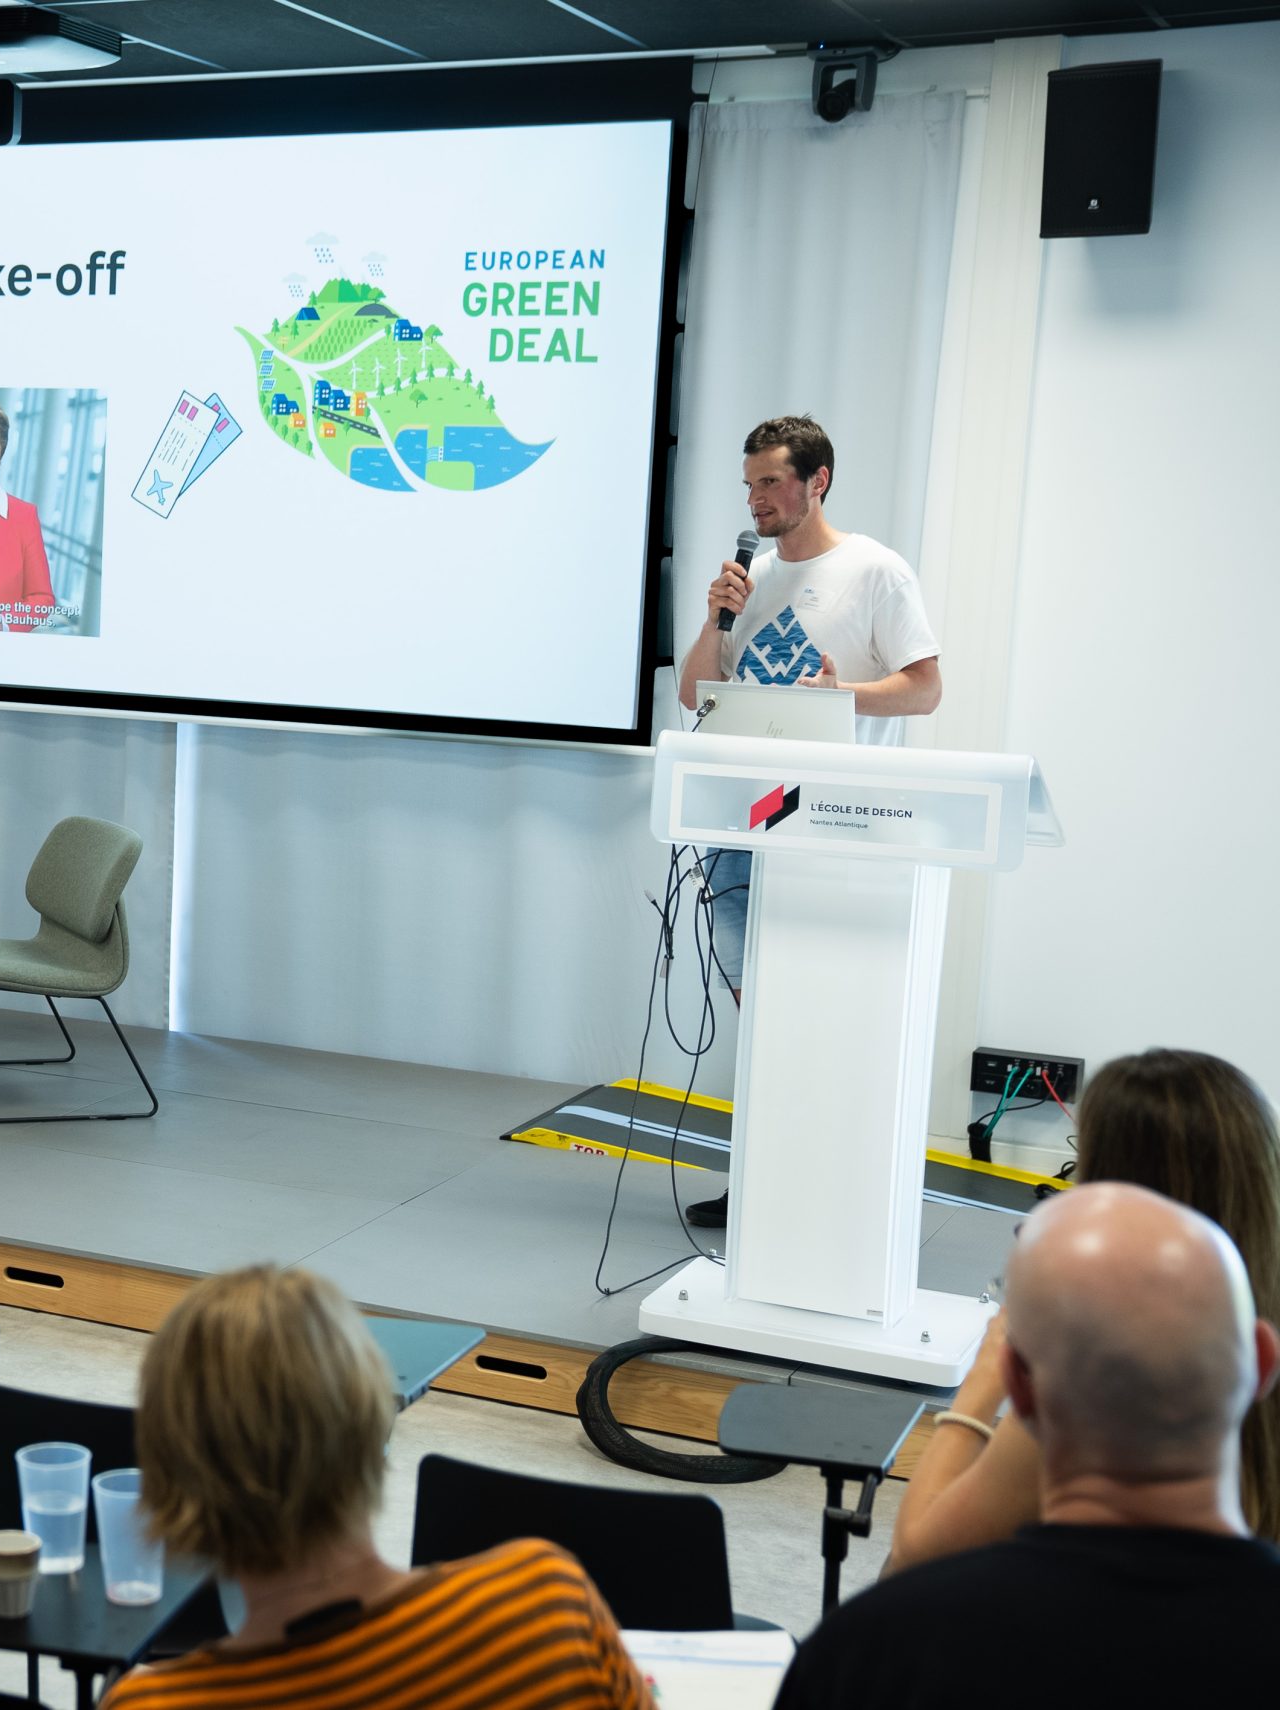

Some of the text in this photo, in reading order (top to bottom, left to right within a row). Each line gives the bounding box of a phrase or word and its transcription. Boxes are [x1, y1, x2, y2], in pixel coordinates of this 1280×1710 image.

[464, 248, 606, 271] EUROPEAN
[462, 280, 601, 318] GREEN
[488, 327, 599, 363] DEAL
[14, 602, 32, 613] the
[34, 604, 81, 617] concept
[5, 613, 56, 627] Bauhaus.
[810, 800, 913, 818] L'ÉCOLE DE DESIGN
[834, 820, 869, 829] Atlantique
